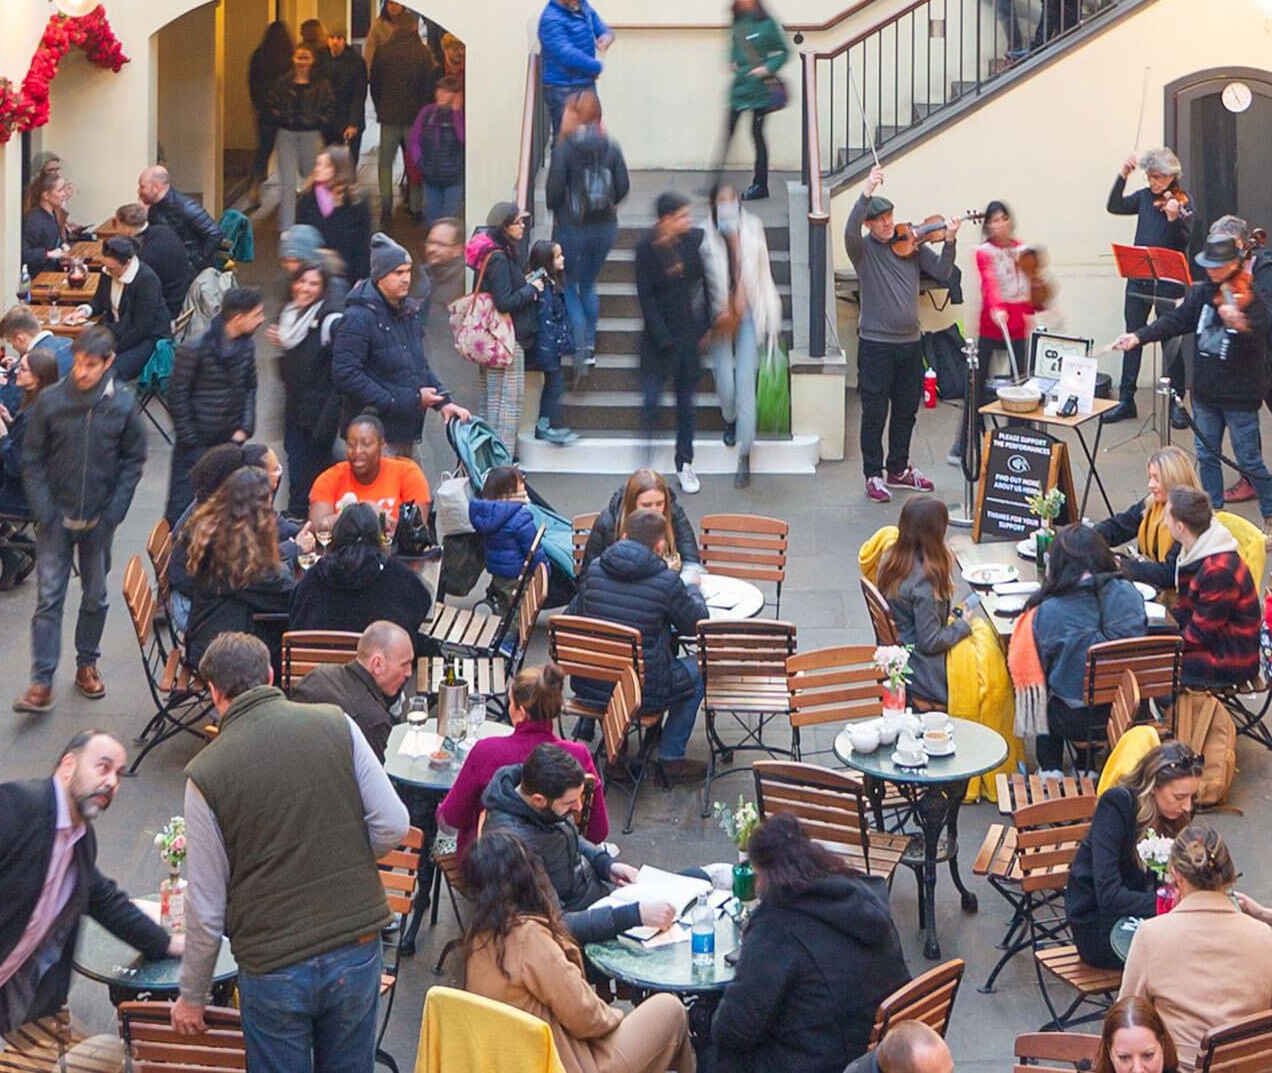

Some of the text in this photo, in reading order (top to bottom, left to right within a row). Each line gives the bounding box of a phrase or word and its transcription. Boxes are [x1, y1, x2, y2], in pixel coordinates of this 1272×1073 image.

[1045, 349, 1058, 359] CD
[998, 432, 1047, 446] PLEASE SUPPORT
[993, 439, 1050, 456] THE PERFORMANCES
[995, 473, 1040, 487] FIND OUT MORE
[993, 482, 1013, 493] ABOUT
[1014, 485, 1022, 493] US
[986, 511, 1039, 527] THANKS FOR YOUR
[998, 521, 1025, 532] SUPPORT
